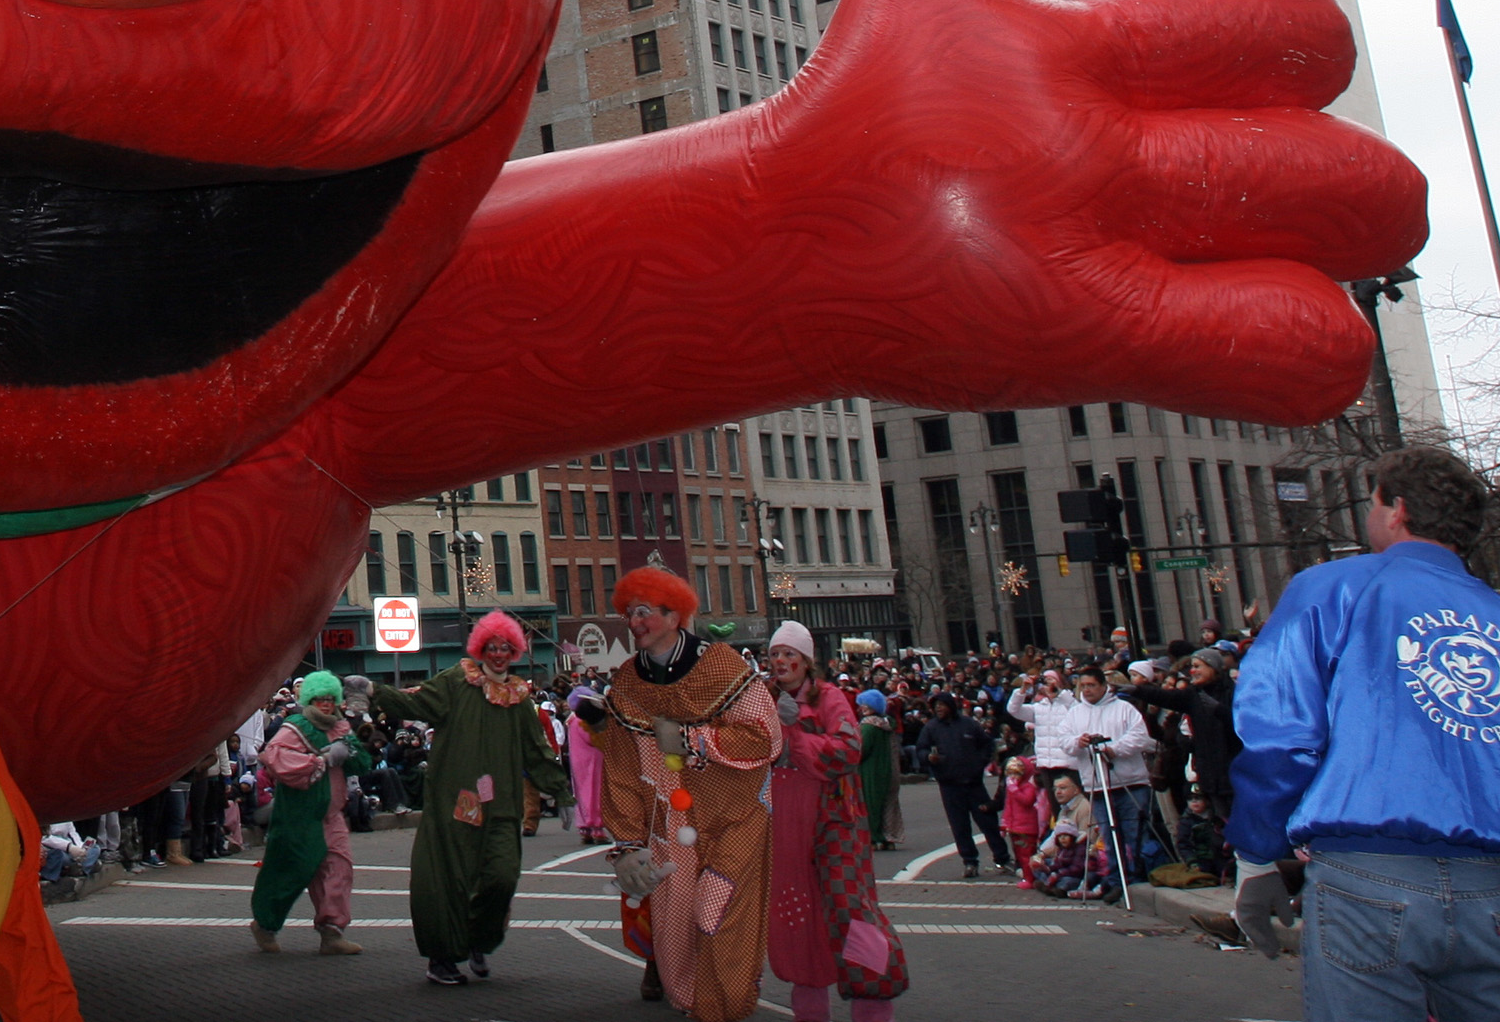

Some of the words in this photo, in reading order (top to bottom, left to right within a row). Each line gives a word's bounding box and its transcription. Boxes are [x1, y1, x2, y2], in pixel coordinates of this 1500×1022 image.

[381, 608, 393, 618] DO
[395, 608, 411, 618] NOT
[384, 630, 410, 641] ENTER
[1404, 678, 1476, 742] FLIGHT
